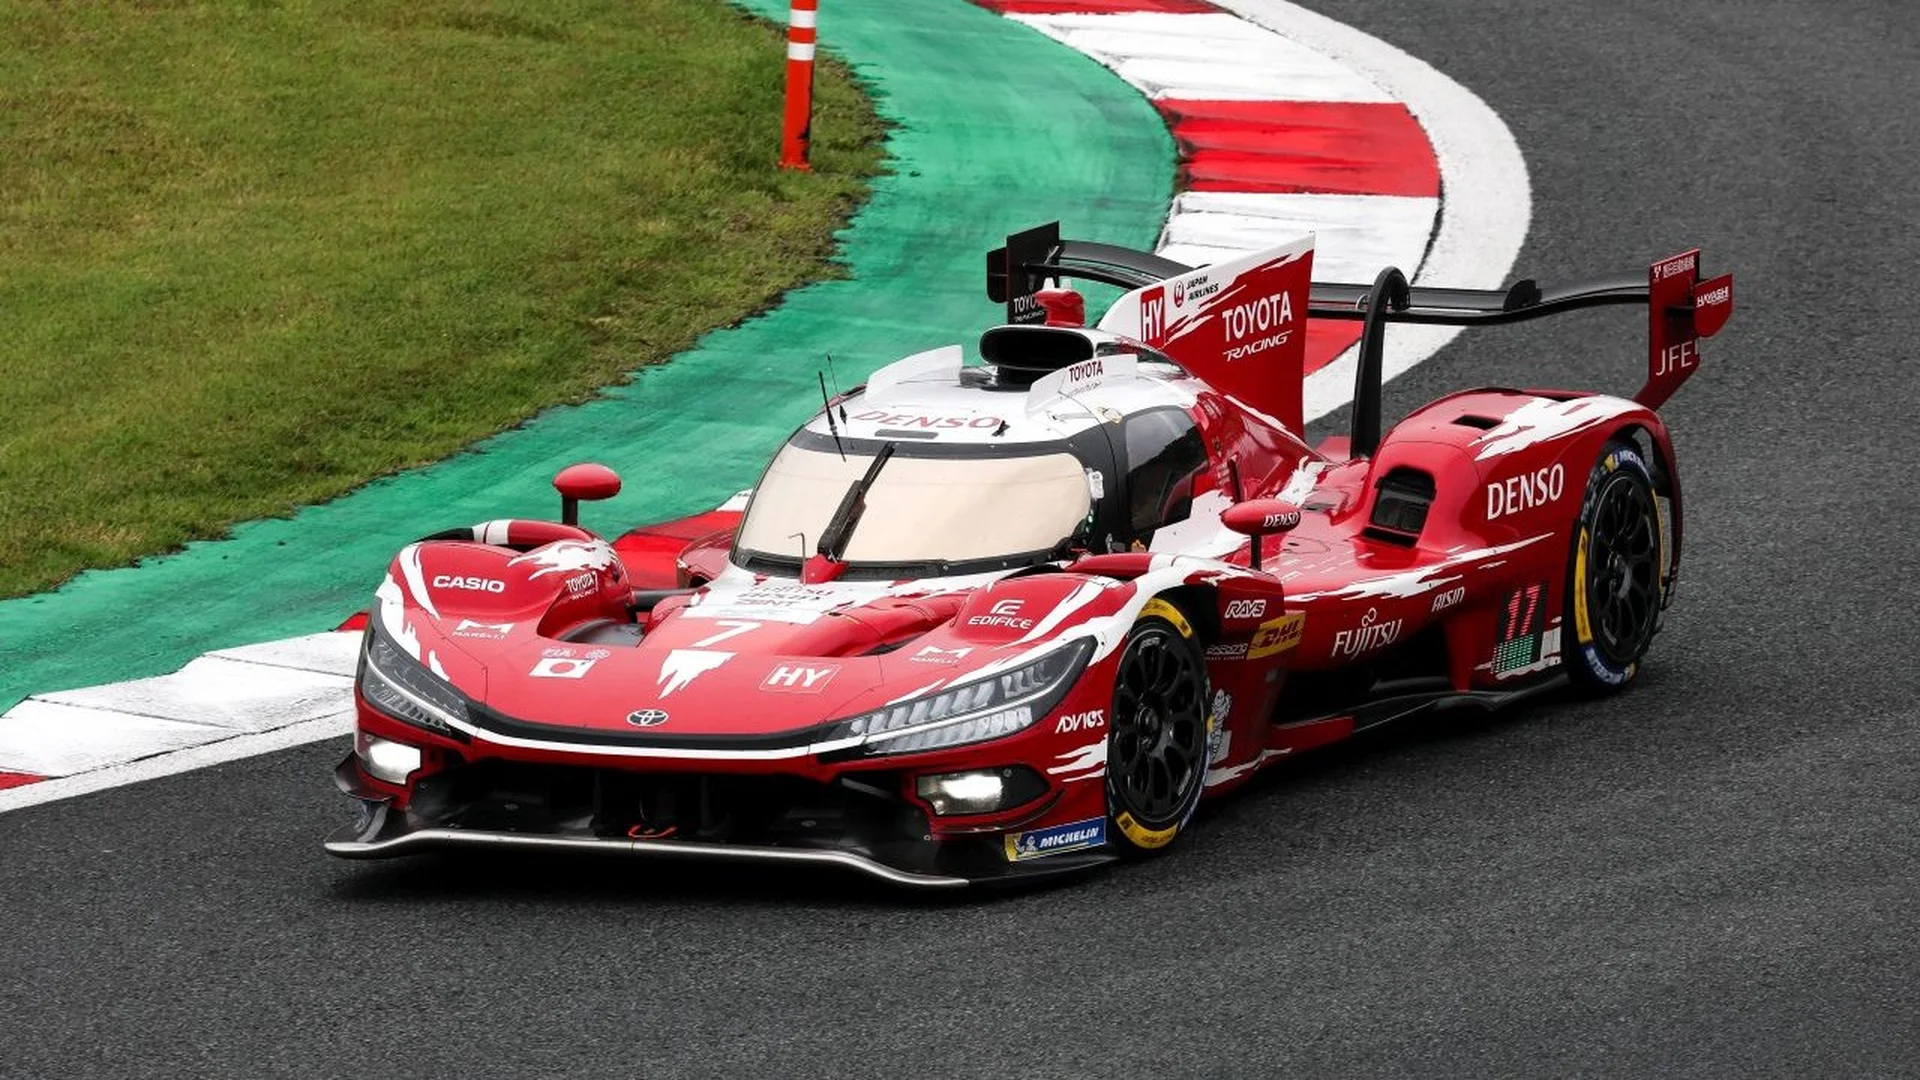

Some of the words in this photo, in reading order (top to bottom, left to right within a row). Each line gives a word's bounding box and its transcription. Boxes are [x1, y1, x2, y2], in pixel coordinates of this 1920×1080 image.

[1186, 275, 1208, 290] JAPAN
[1188, 283, 1219, 301] AIRLINES
[1142, 297, 1162, 342] HY
[1222, 290, 1293, 342] TOYOTA
[1223, 330, 1293, 362] RACING
[1656, 341, 1692, 376] JFE
[1069, 360, 1104, 383] TOYOTA
[852, 410, 1001, 428] DENSO
[1488, 463, 1564, 520] DENSO
[1263, 511, 1299, 527] DENSO
[433, 575, 505, 593] CASIO
[1224, 599, 1267, 619] RAYS
[1431, 586, 1465, 613] AISIN
[689, 619, 762, 648] 7
[967, 615, 1033, 630] EDIFICE
[1331, 619, 1403, 660] FUJITSU
[767, 666, 833, 688] HY
[1039, 827, 1100, 849] MICHELIN
